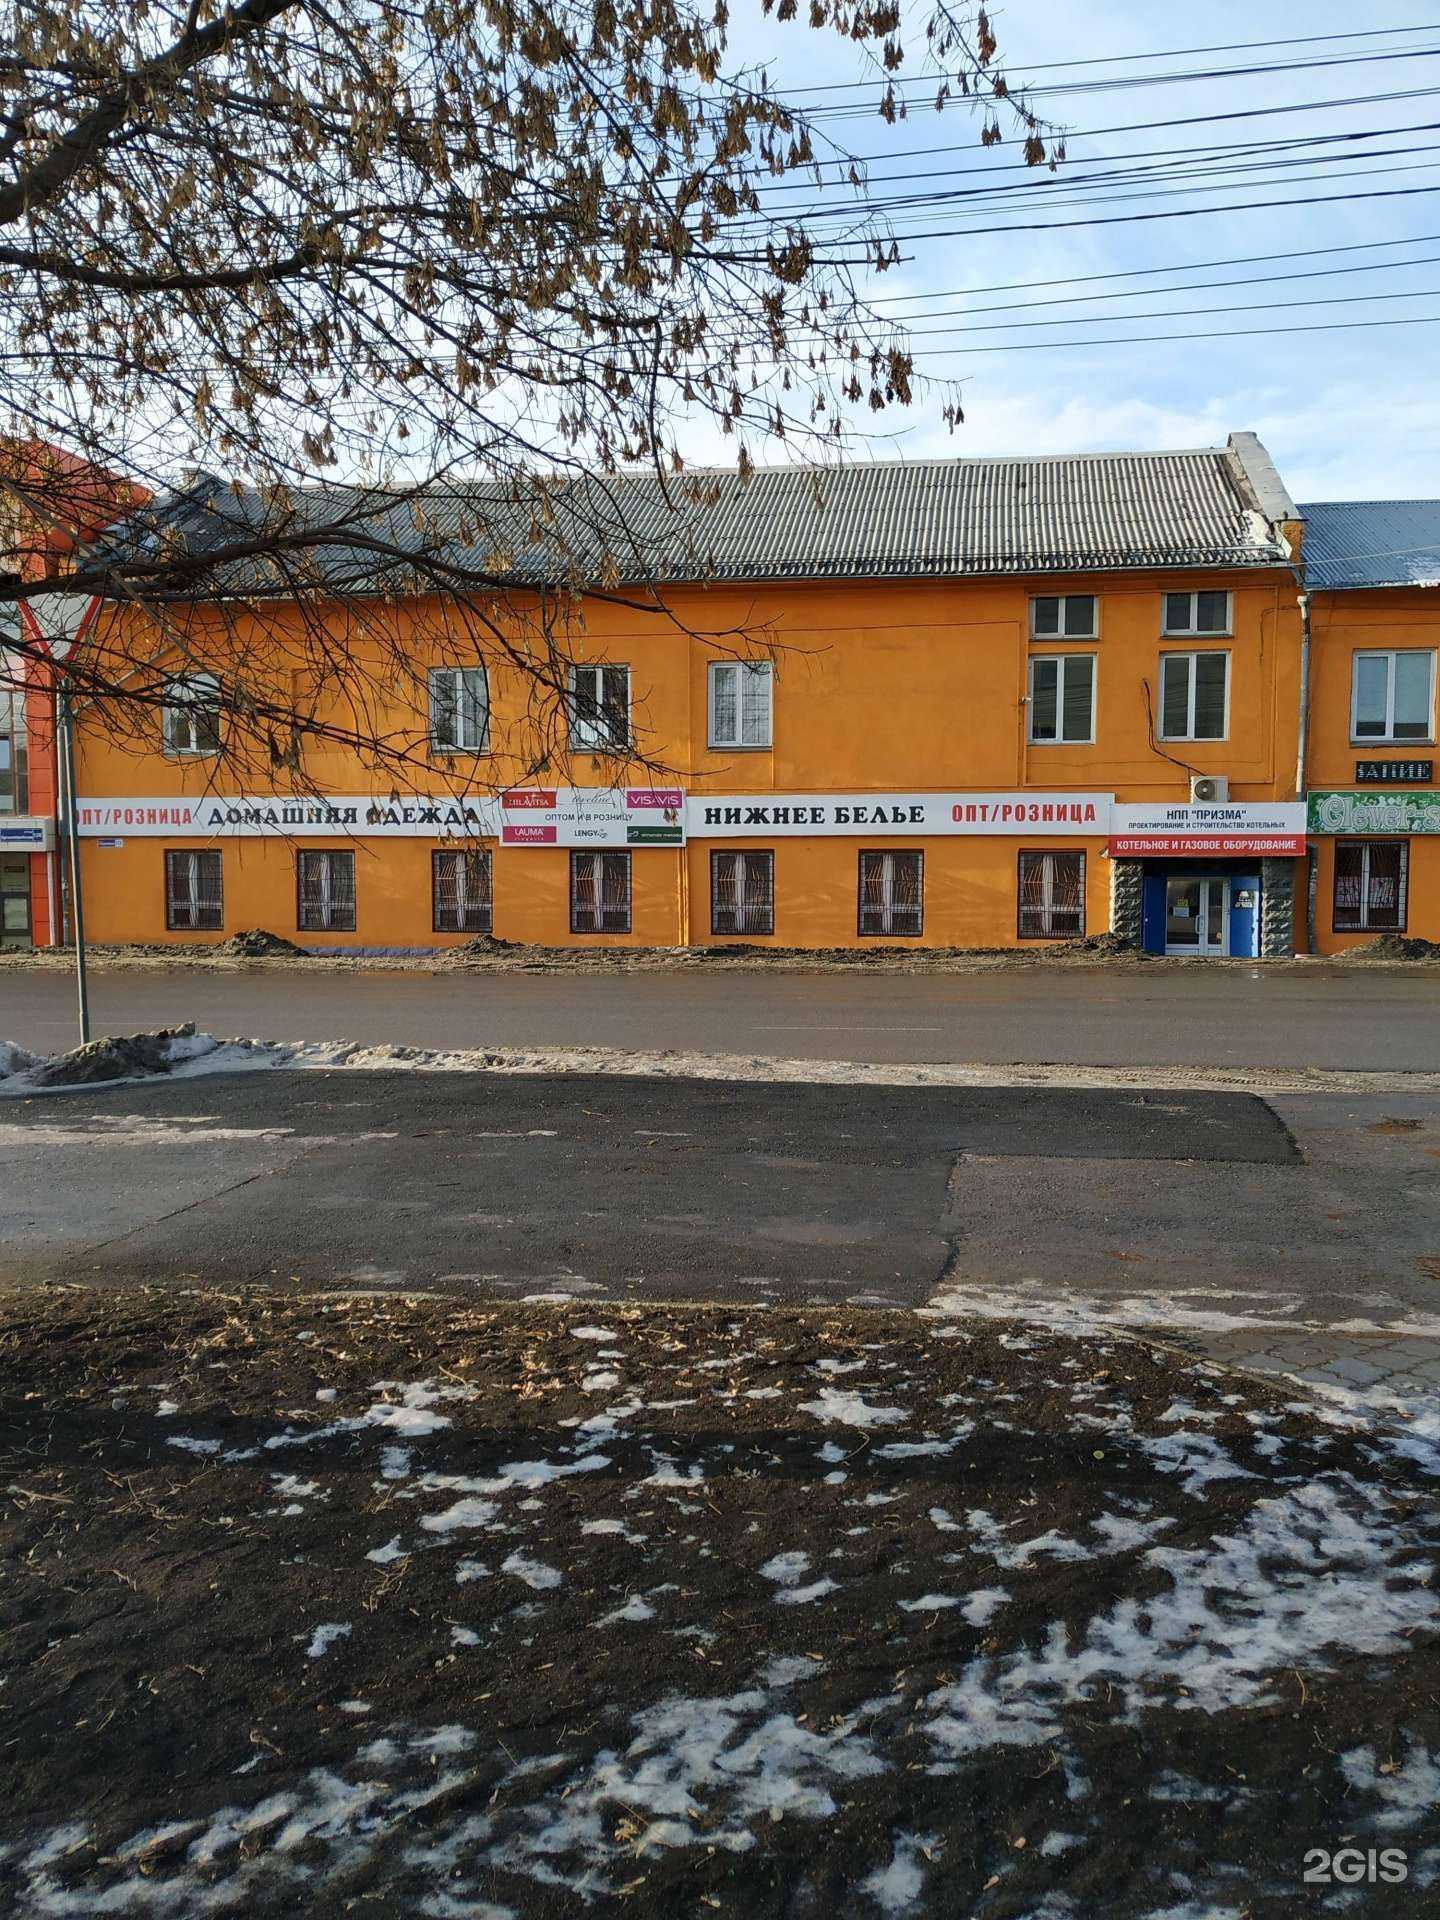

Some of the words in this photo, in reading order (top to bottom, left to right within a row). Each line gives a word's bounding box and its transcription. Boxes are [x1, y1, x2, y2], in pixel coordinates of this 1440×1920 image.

[208, 807, 357, 826] ДОМАШНЯЯ
[544, 812, 574, 822] ОПТОМ
[593, 812, 633, 822] РОЗНИЦУ
[704, 807, 826, 825] НИЖНЕЕ
[834, 806, 926, 825] БЕЛЬЕ
[951, 803, 1096, 824] ОПТ/РОЗНИЦА
[1166, 810, 1189, 820] НПП
[1191, 809, 1247, 820] "ПРИЗМА"
[1116, 840, 1169, 850] КОТЕЛЬНОЕ
[1171, 840, 1178, 849] И
[1180, 840, 1220, 850] ГАЗОВОЕ
[1223, 839, 1297, 850] ОБОРУДОВАНИЕ
